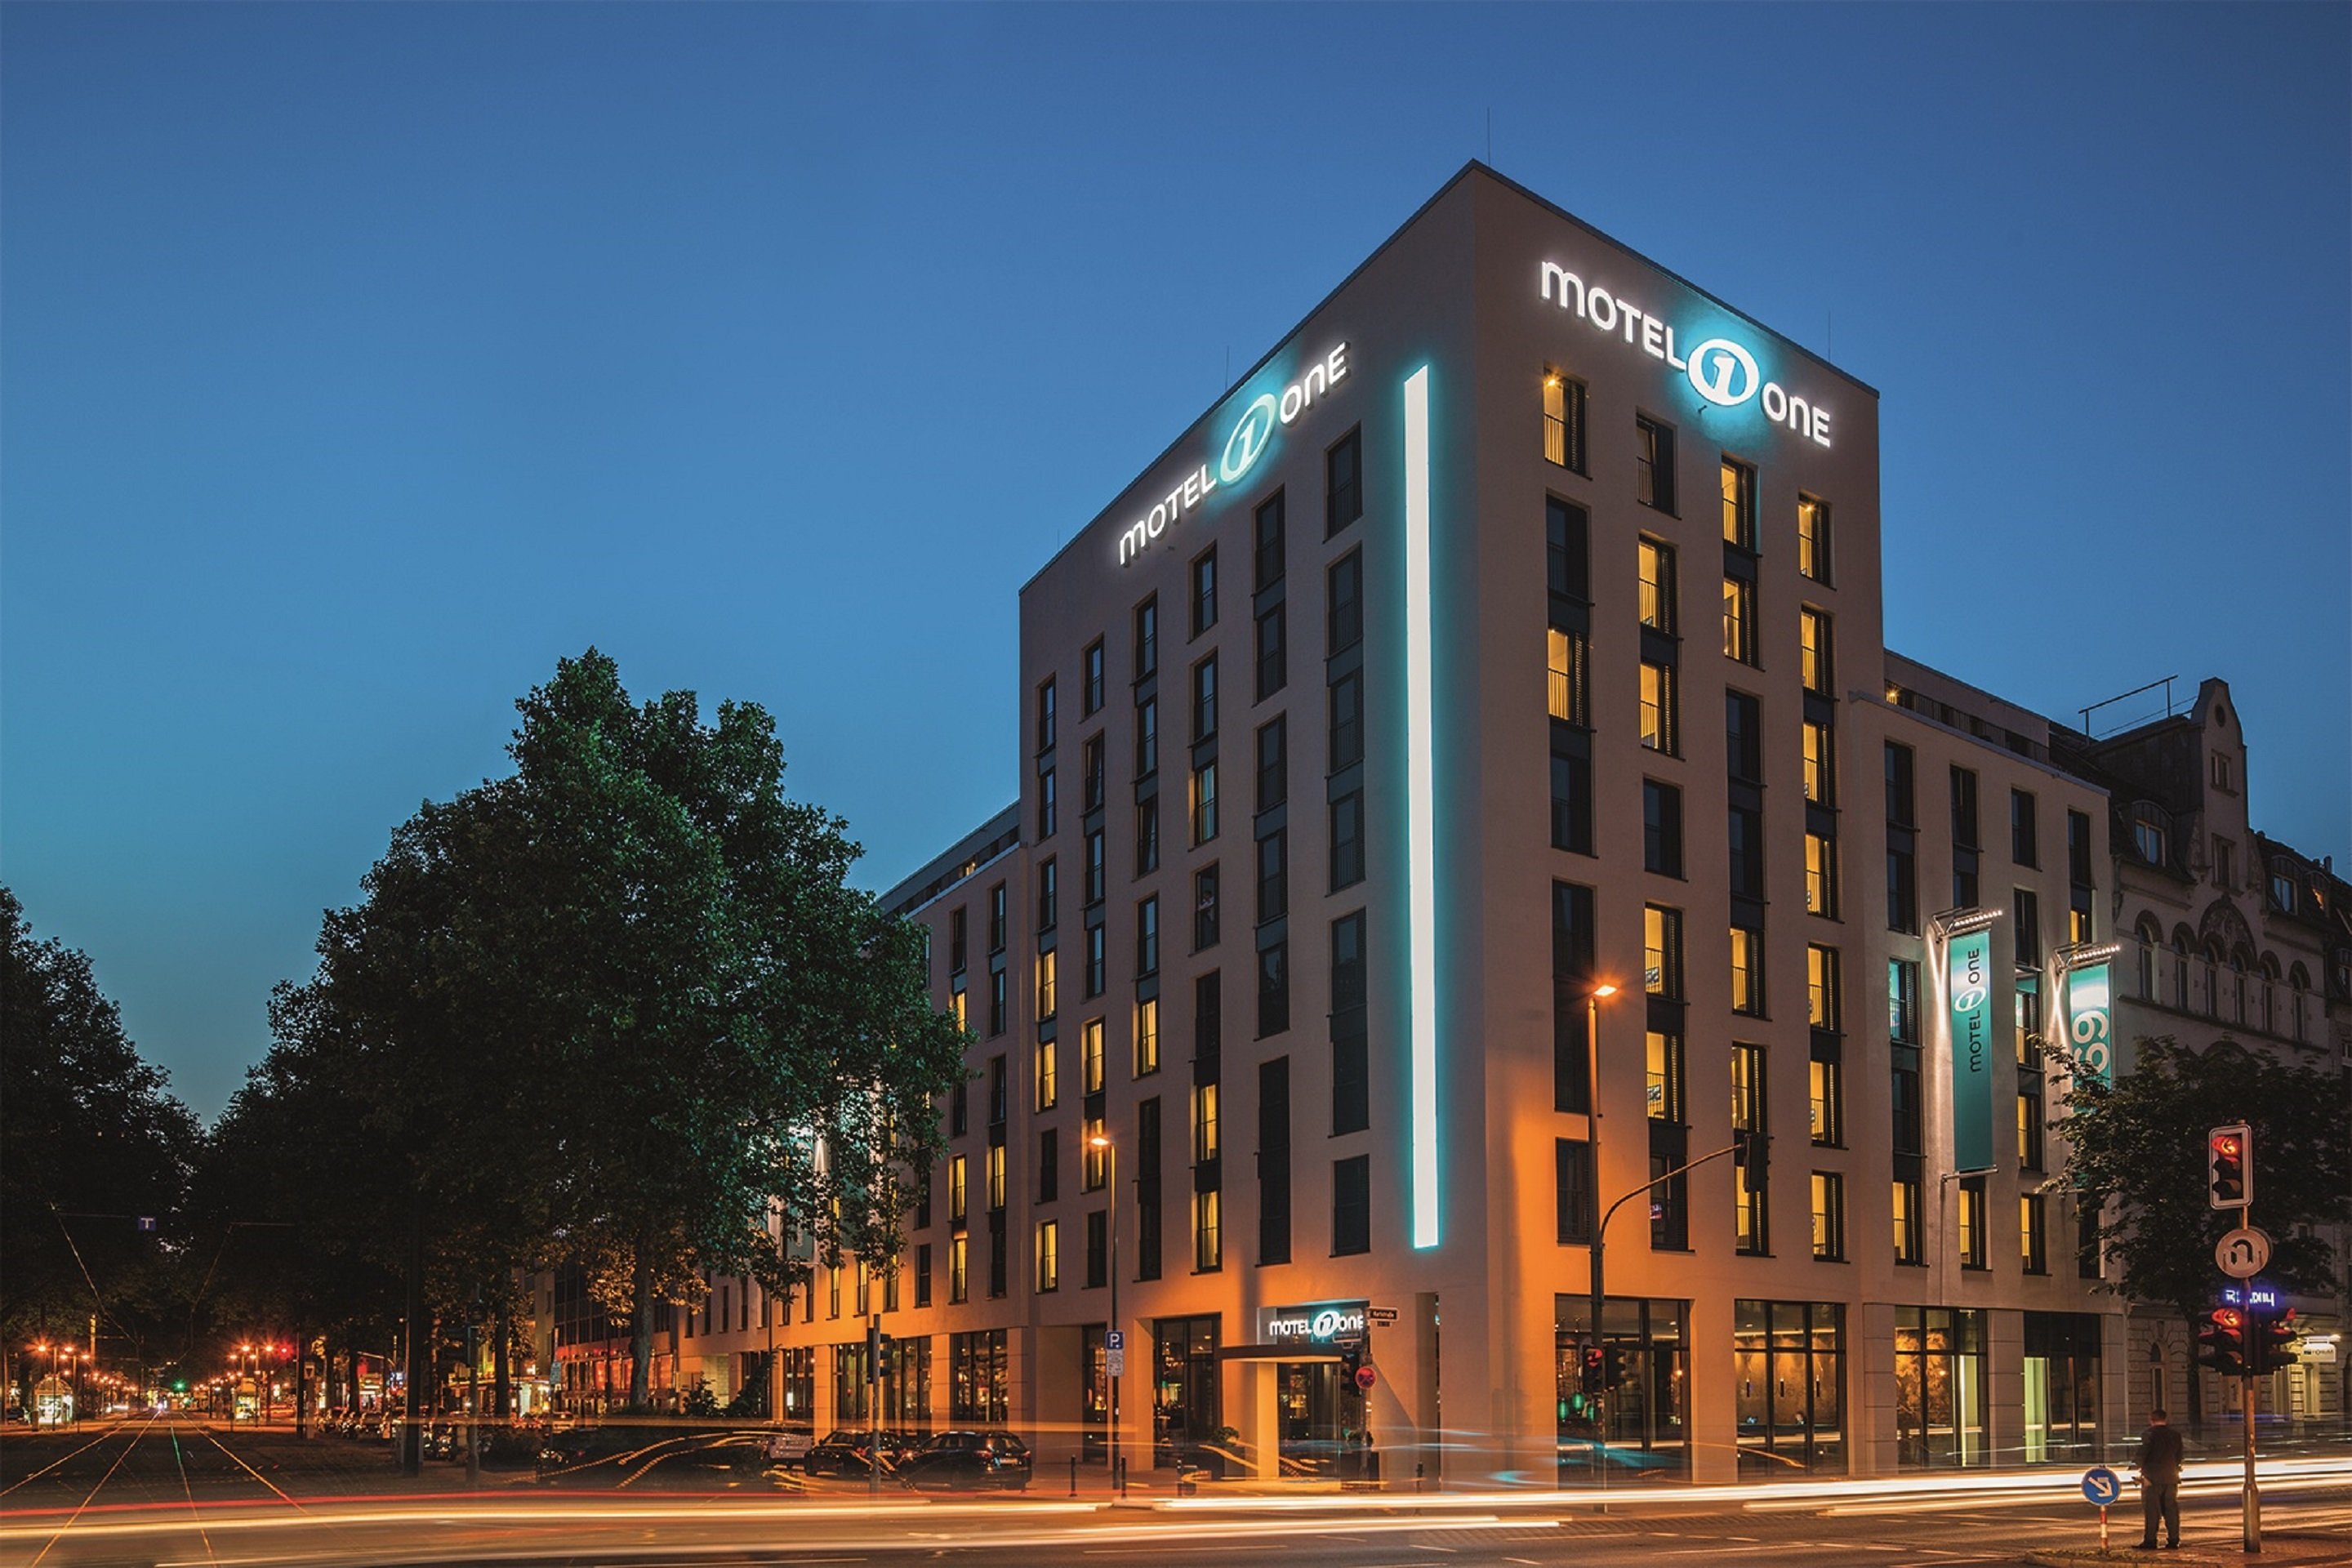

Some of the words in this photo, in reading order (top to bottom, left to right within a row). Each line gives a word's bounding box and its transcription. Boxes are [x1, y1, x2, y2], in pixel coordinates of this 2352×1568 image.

[1542, 261, 1686, 371] MOTEL
[1762, 381, 1831, 448] ONE
[1120, 464, 1217, 565] MOTEL
[1280, 341, 1348, 425] ONE
[1967, 947, 1980, 985] ONE
[1968, 1009, 1982, 1073] MOTEL
[140, 1218, 154, 1229] T
[1110, 1333, 1120, 1348] P
[1269, 1318, 1312, 1336] MOTEL
[1339, 1315, 1364, 1332] ONE
